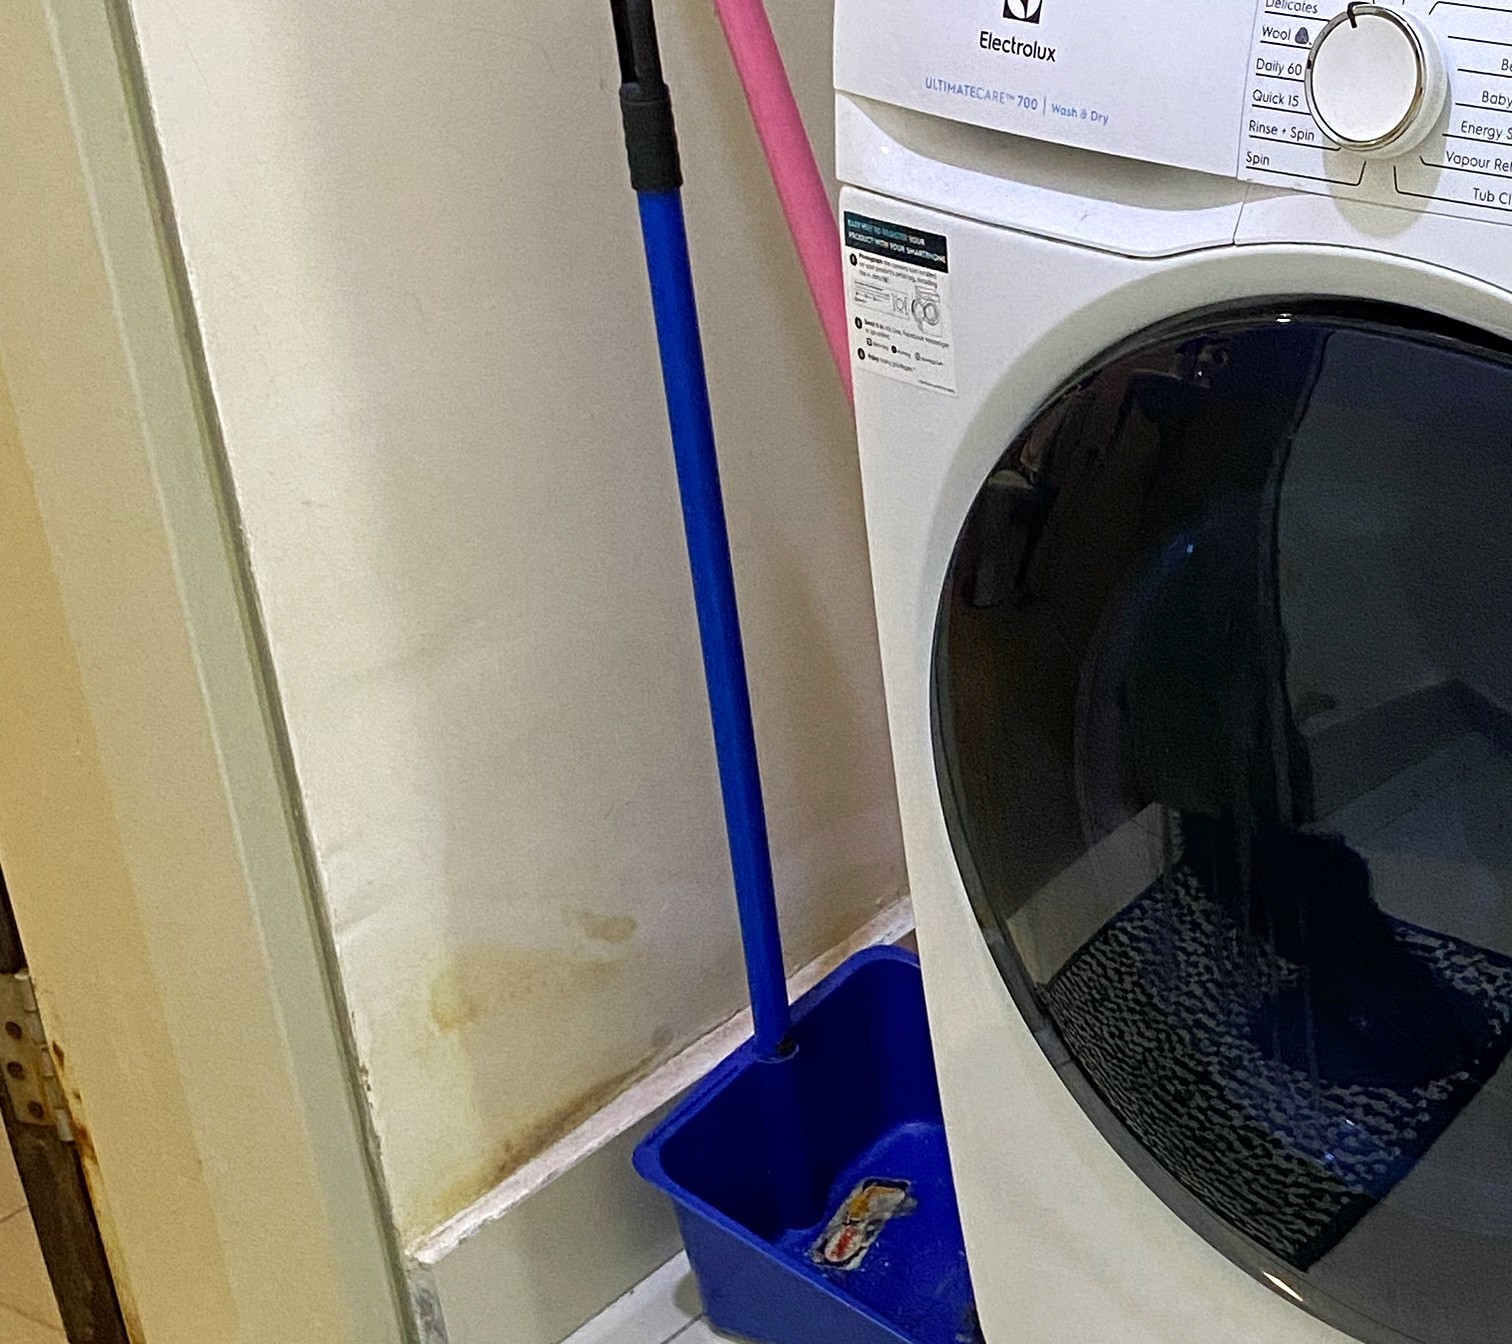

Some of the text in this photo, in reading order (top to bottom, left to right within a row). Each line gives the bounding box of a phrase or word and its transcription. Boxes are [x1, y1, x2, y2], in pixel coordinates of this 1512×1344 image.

[1261, 25, 1291, 41] Wool
[979, 30, 1056, 63] Electrolux
[1256, 58, 1303, 76] Daily 60
[1252, 89, 1300, 107] Quick 15
[1017, 94, 1038, 110] 700
[1051, 103, 1077, 118] Wash
[1090, 110, 1109, 126] Dry
[1249, 120, 1279, 136] Rinse
[1290, 126, 1315, 143] Spin
[1460, 121, 1503, 141] Energy
[1246, 151, 1270, 167] Spin
[1446, 151, 1489, 173] Vapour
[1472, 187, 1495, 205] Tub
